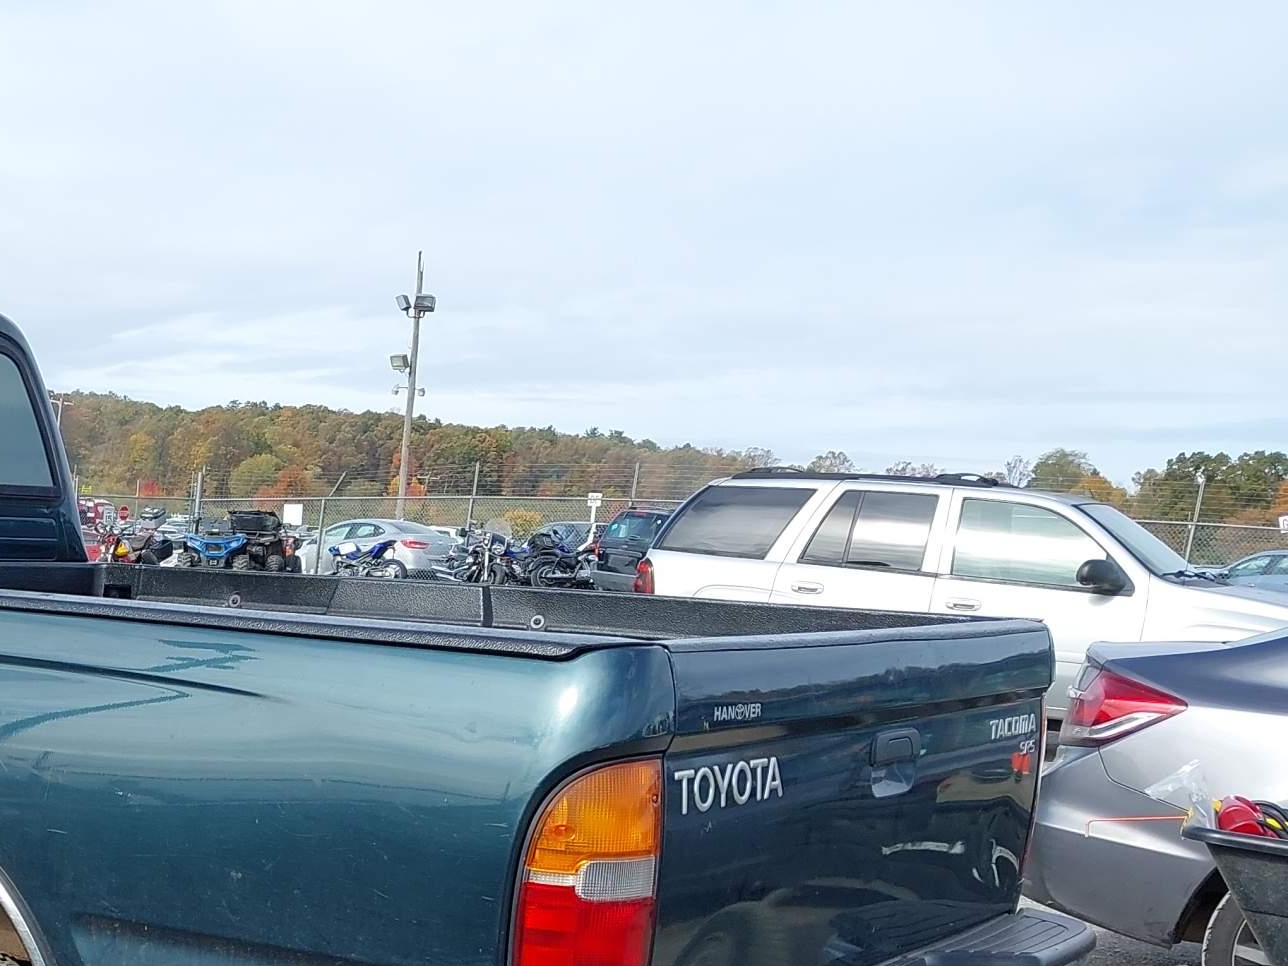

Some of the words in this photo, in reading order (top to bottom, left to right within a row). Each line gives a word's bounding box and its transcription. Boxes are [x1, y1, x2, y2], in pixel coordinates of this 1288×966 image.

[713, 703, 762, 722] HANOVER
[989, 713, 1037, 740] TACOMA
[674, 756, 784, 815] TOYOTA
